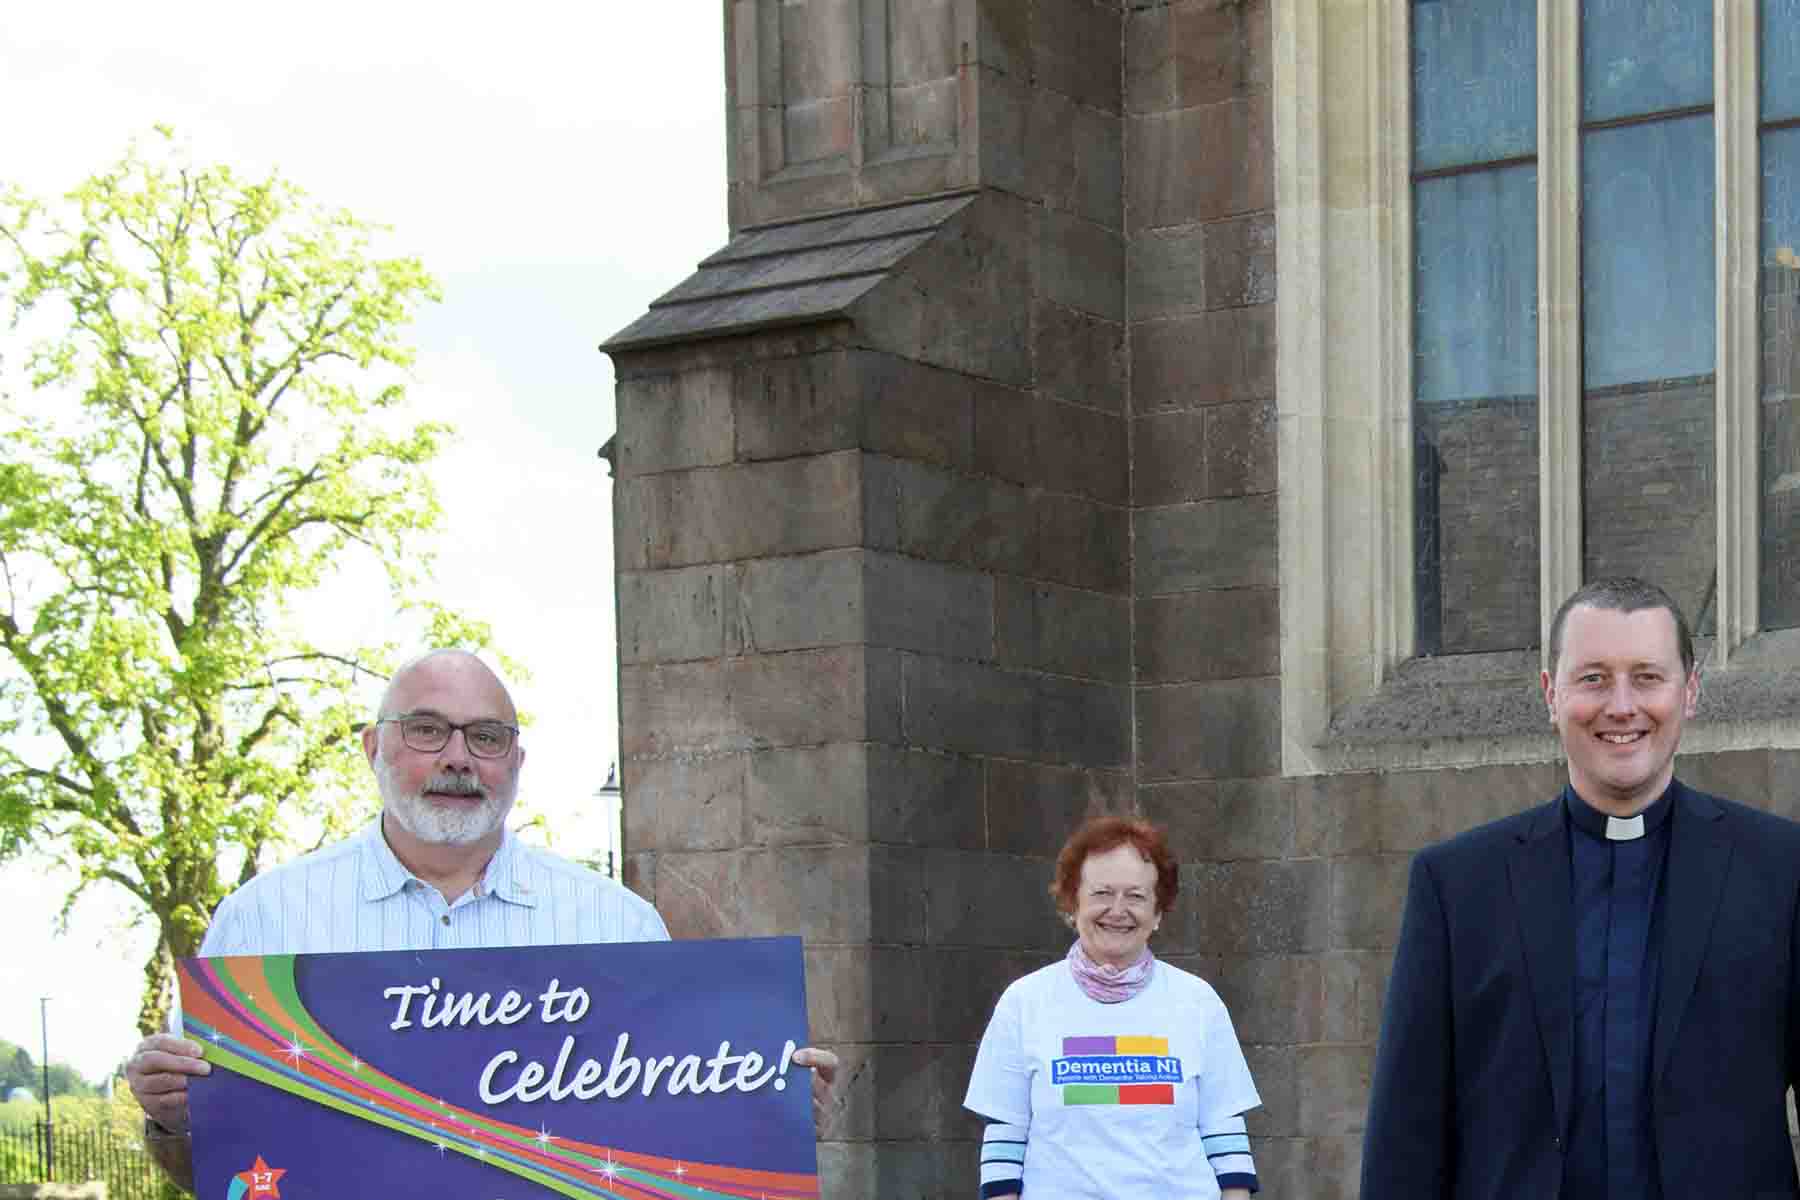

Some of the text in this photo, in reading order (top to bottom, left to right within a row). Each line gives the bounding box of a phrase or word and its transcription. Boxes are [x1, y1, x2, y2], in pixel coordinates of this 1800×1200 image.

[383, 976, 591, 1031] Time to
[478, 1032, 796, 1105] Celebrate!
[1056, 1059, 1178, 1075] Dementia NI
